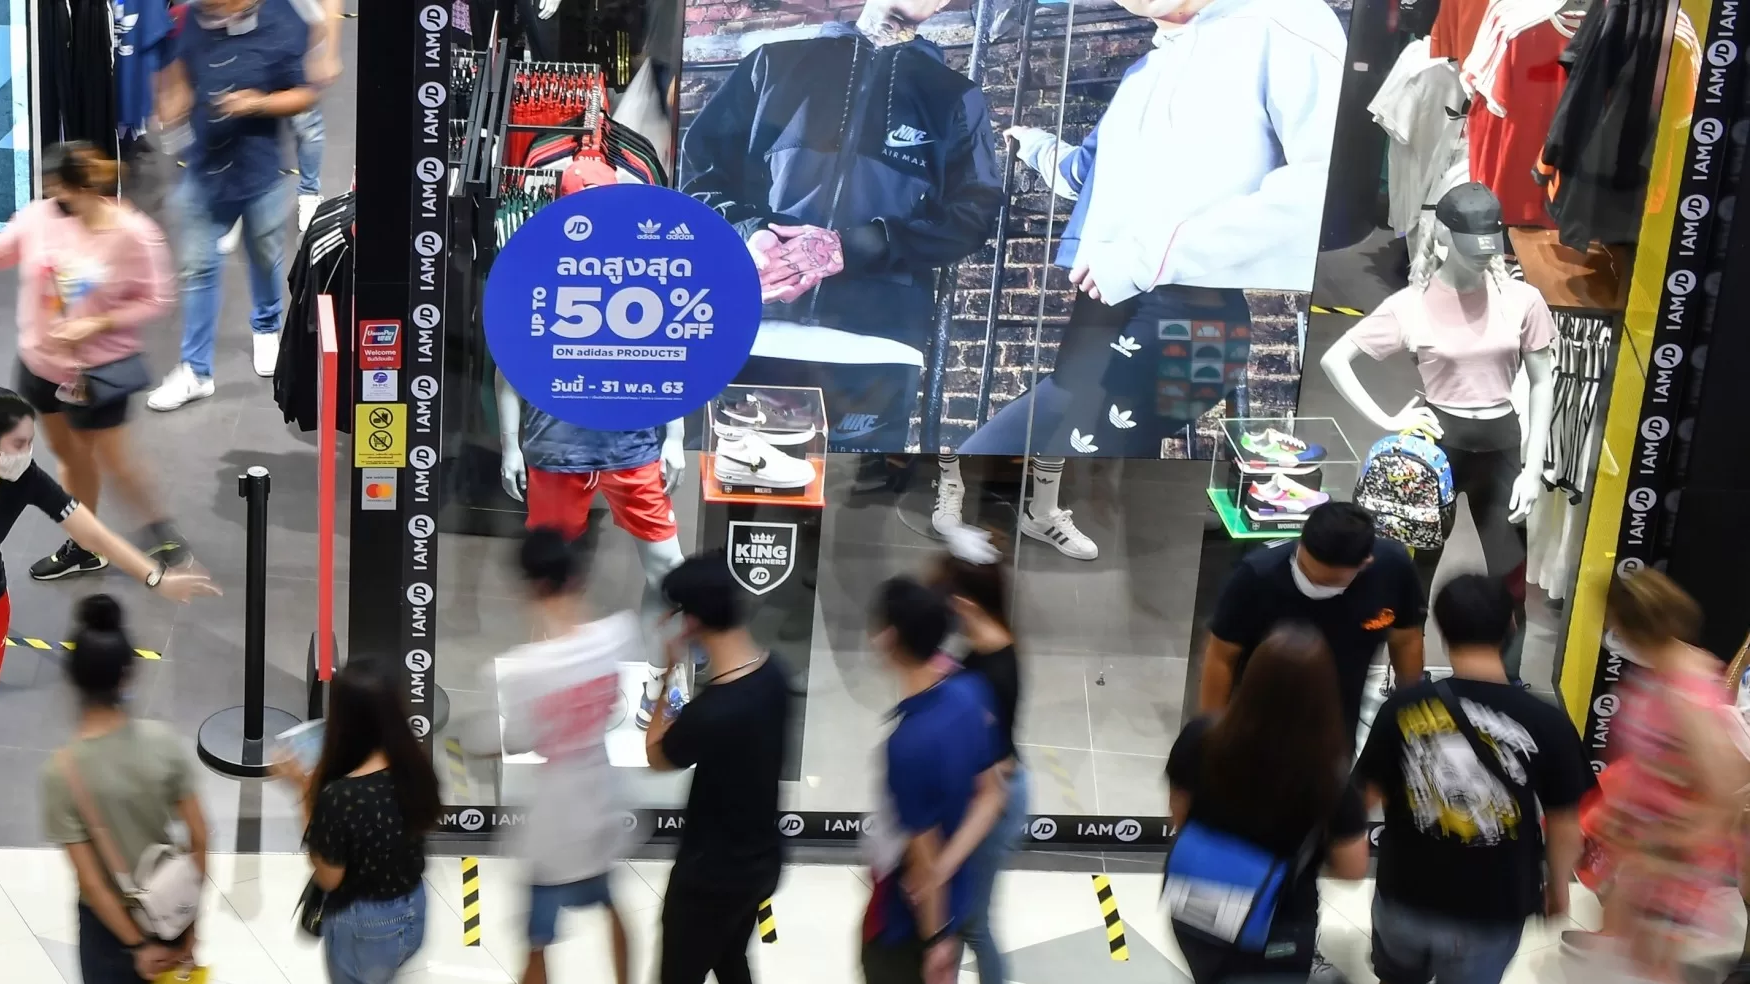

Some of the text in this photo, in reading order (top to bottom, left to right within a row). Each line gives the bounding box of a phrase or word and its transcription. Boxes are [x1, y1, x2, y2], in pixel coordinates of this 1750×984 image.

[427, 8, 440, 27] JD
[1715, 44, 1729, 62] JD
[893, 124, 927, 141] NIKE
[1701, 122, 1715, 140] JD
[882, 149, 927, 167] AIR MAX
[424, 160, 436, 178] JD
[567, 222, 588, 234] JD
[422, 234, 435, 252] JD
[556, 256, 692, 285] ลดสูงสุด
[1674, 274, 1688, 291] JD
[532, 286, 547, 309] TO
[531, 310, 546, 337] UP
[665, 322, 714, 339] OFF
[556, 348, 574, 356] ON
[576, 347, 613, 358] adidas
[1661, 347, 1675, 365] JD
[418, 379, 430, 396] JD
[551, 375, 585, 393] วันนี้
[601, 380, 619, 393] 31
[625, 382, 656, 394] พ.ค.
[661, 381, 684, 394] 63
[838, 413, 879, 430] NIKE
[416, 449, 429, 466] JD
[1636, 491, 1649, 508] JD
[735, 543, 788, 559] KING
[744, 557, 786, 565] TRAINERS
[752, 571, 767, 580] JD
[414, 586, 426, 602] JD
[412, 652, 424, 668] JD
[463, 814, 481, 825] JD
[782, 819, 800, 831] JD
[1034, 824, 1053, 835] JD
[1118, 825, 1138, 836] JD
